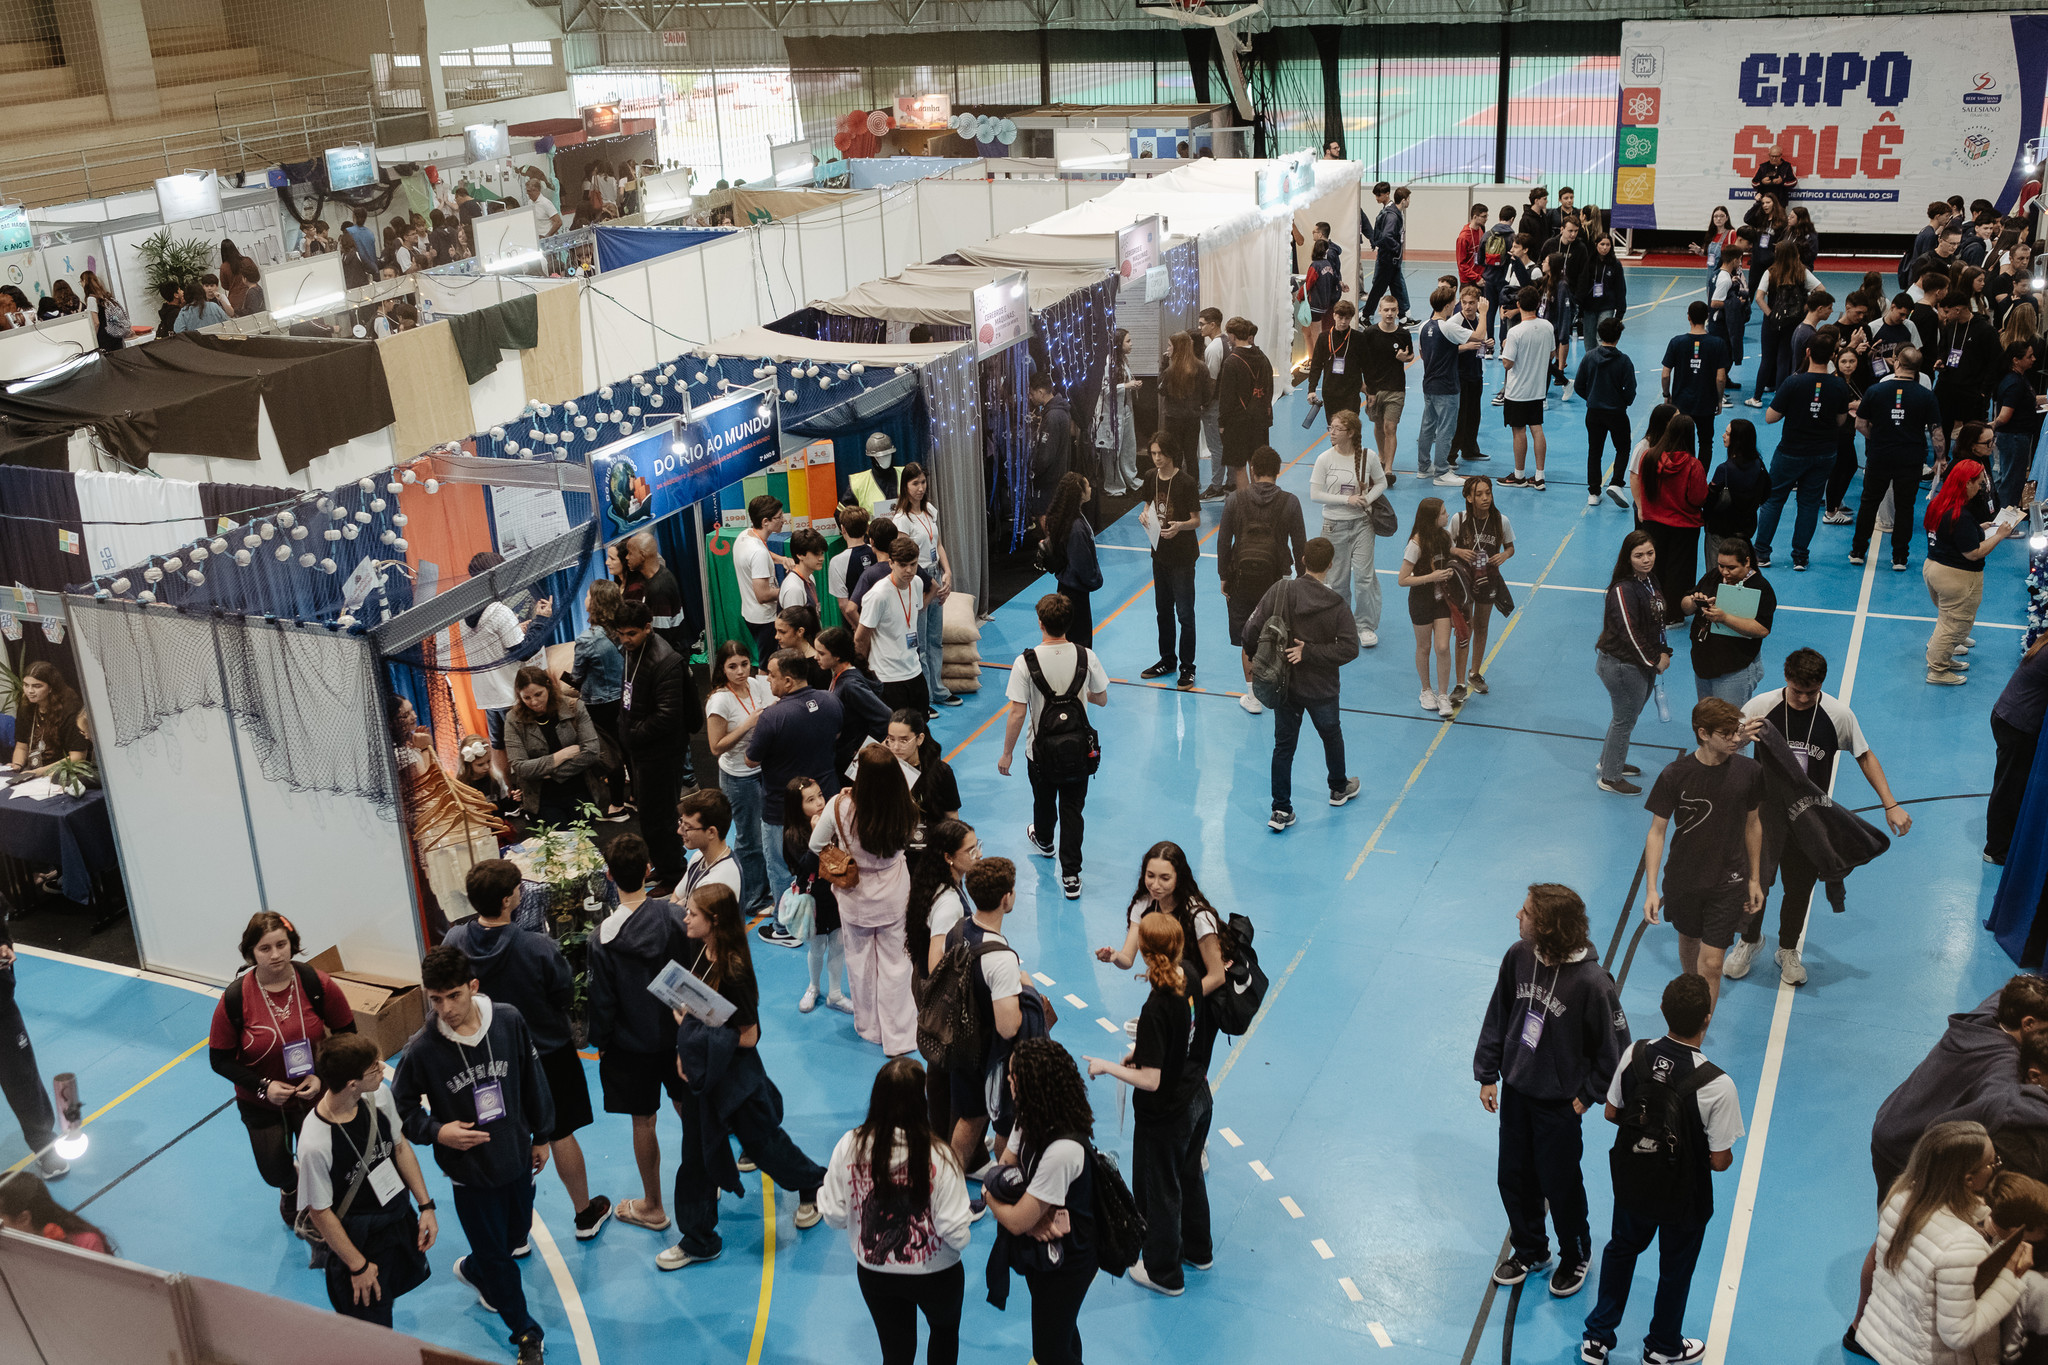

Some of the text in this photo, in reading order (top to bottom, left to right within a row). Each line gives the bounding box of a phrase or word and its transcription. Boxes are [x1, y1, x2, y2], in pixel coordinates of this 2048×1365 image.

[1738, 51, 1912, 107] EXPO
[905, 104, 940, 112] Almanha
[1732, 111, 1905, 179] SALÊ
[1734, 190, 1758, 198] EVENT
[1825, 191, 1831, 199] E
[1831, 192, 1868, 200] CULTURAL
[1868, 192, 1880, 200] DO
[1881, 192, 1893, 200] CSI
[653, 454, 676, 477] DO
[706, 434, 723, 456] AO
[724, 416, 772, 447] MUNDO
